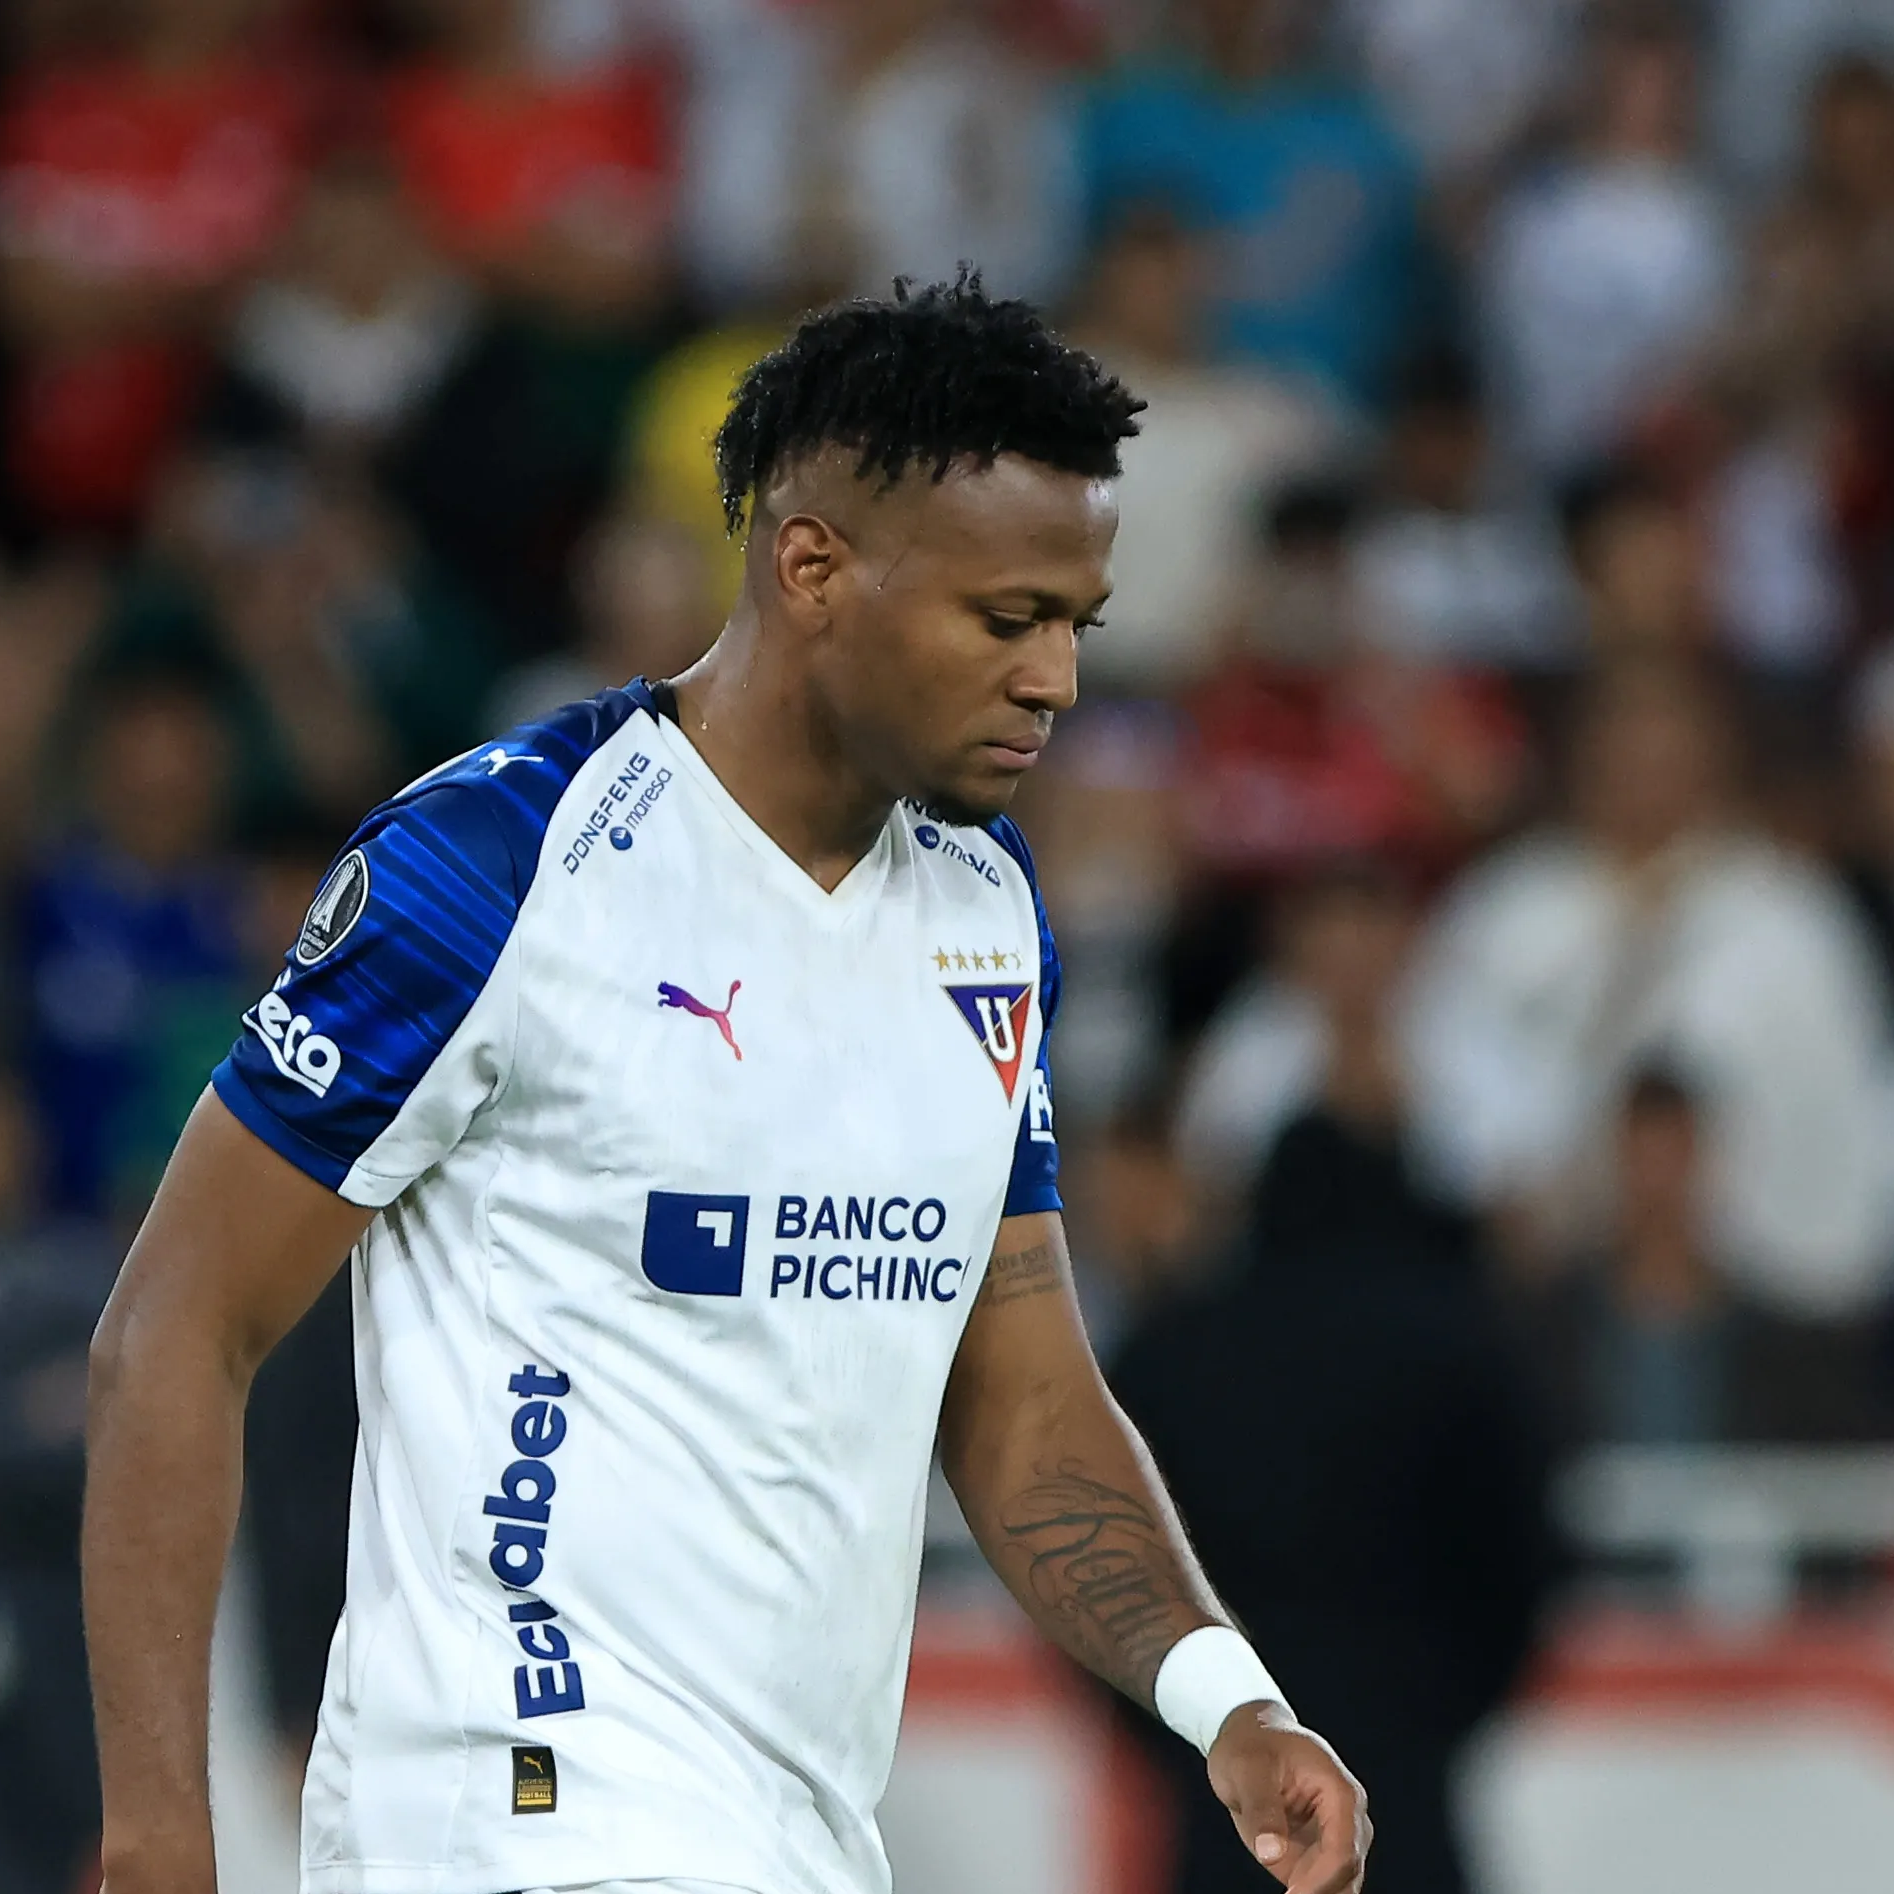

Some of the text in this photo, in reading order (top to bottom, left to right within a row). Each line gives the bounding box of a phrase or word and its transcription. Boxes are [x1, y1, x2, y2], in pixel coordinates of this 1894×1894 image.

[563, 752, 651, 875] DONGFENG
[625, 767, 673, 830] maresa
[974, 996, 1017, 1063] U
[775, 1195, 946, 1242] BANCO
[770, 1255, 972, 1303] PICHINC
